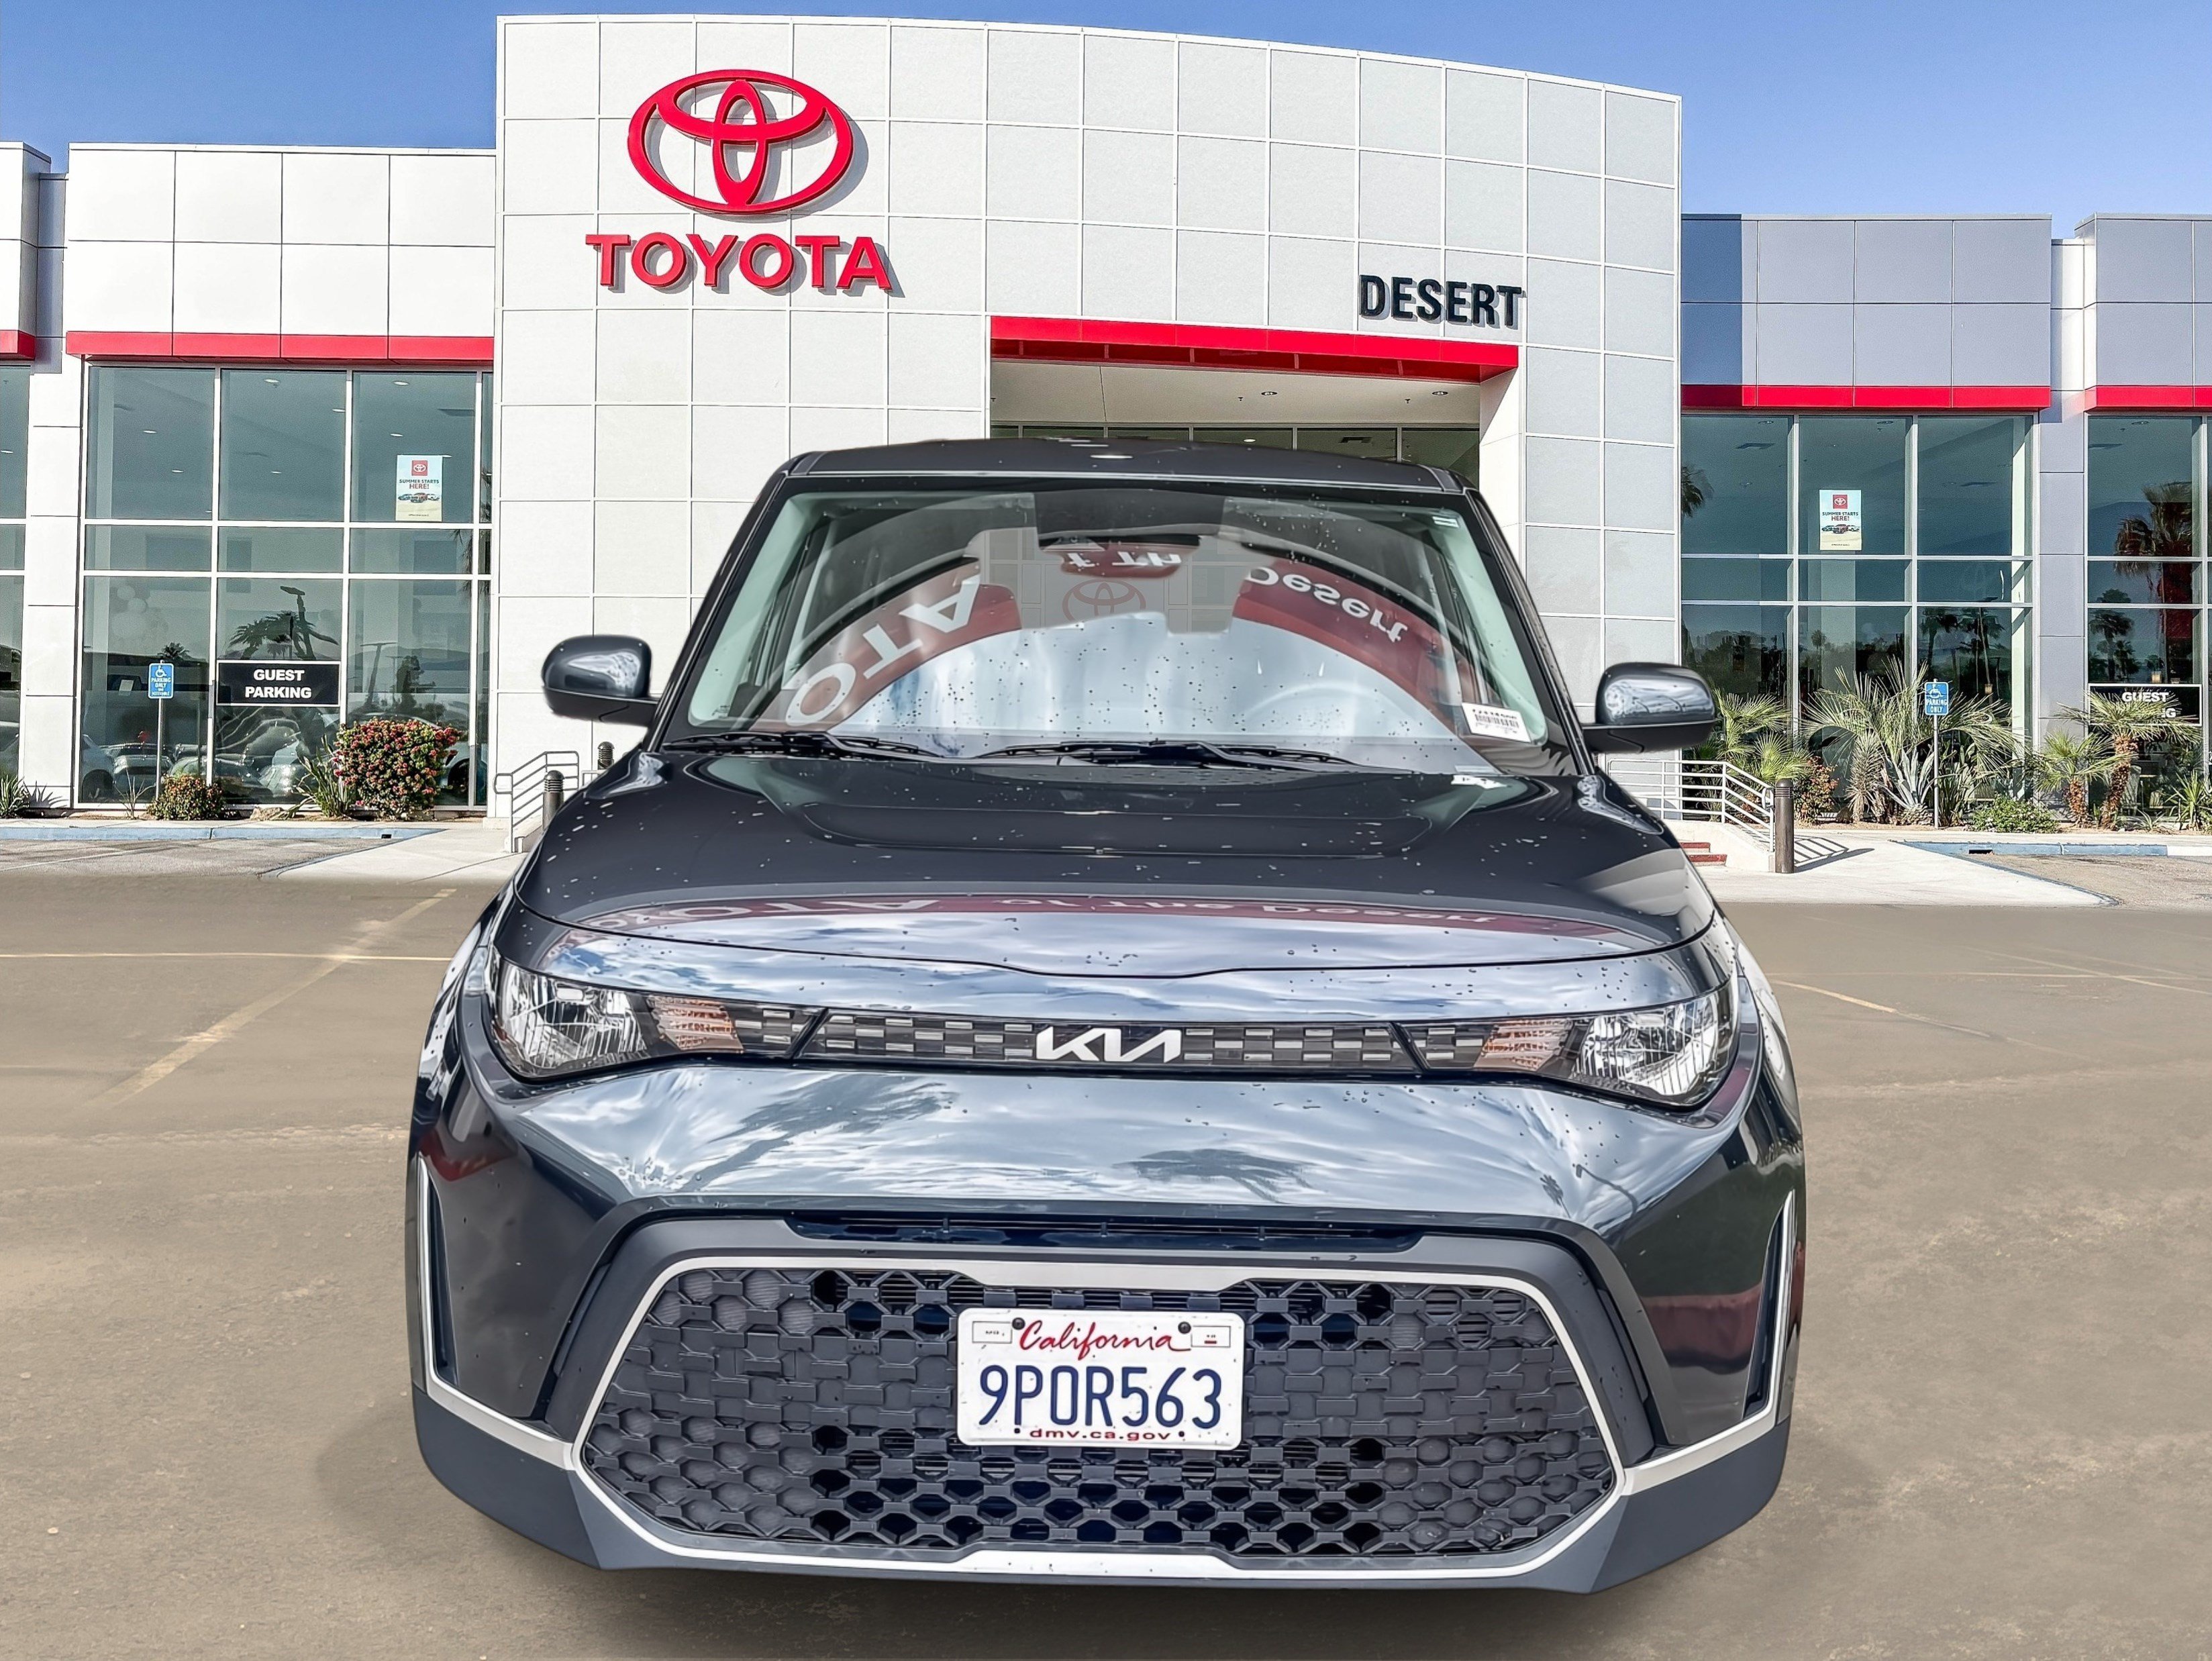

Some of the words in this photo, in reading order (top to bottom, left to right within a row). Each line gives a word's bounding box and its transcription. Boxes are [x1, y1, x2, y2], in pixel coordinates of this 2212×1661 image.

[585, 232, 893, 290] TOYOTA
[1358, 274, 1522, 327] DESERT
[253, 669, 305, 681] GUEST
[245, 687, 312, 699] PARKING
[2121, 691, 2170, 703] GUEST
[1036, 1026, 1182, 1063] KIA
[1019, 1319, 1192, 1360] California
[1029, 1428, 1171, 1442] dmv.ca.gov
